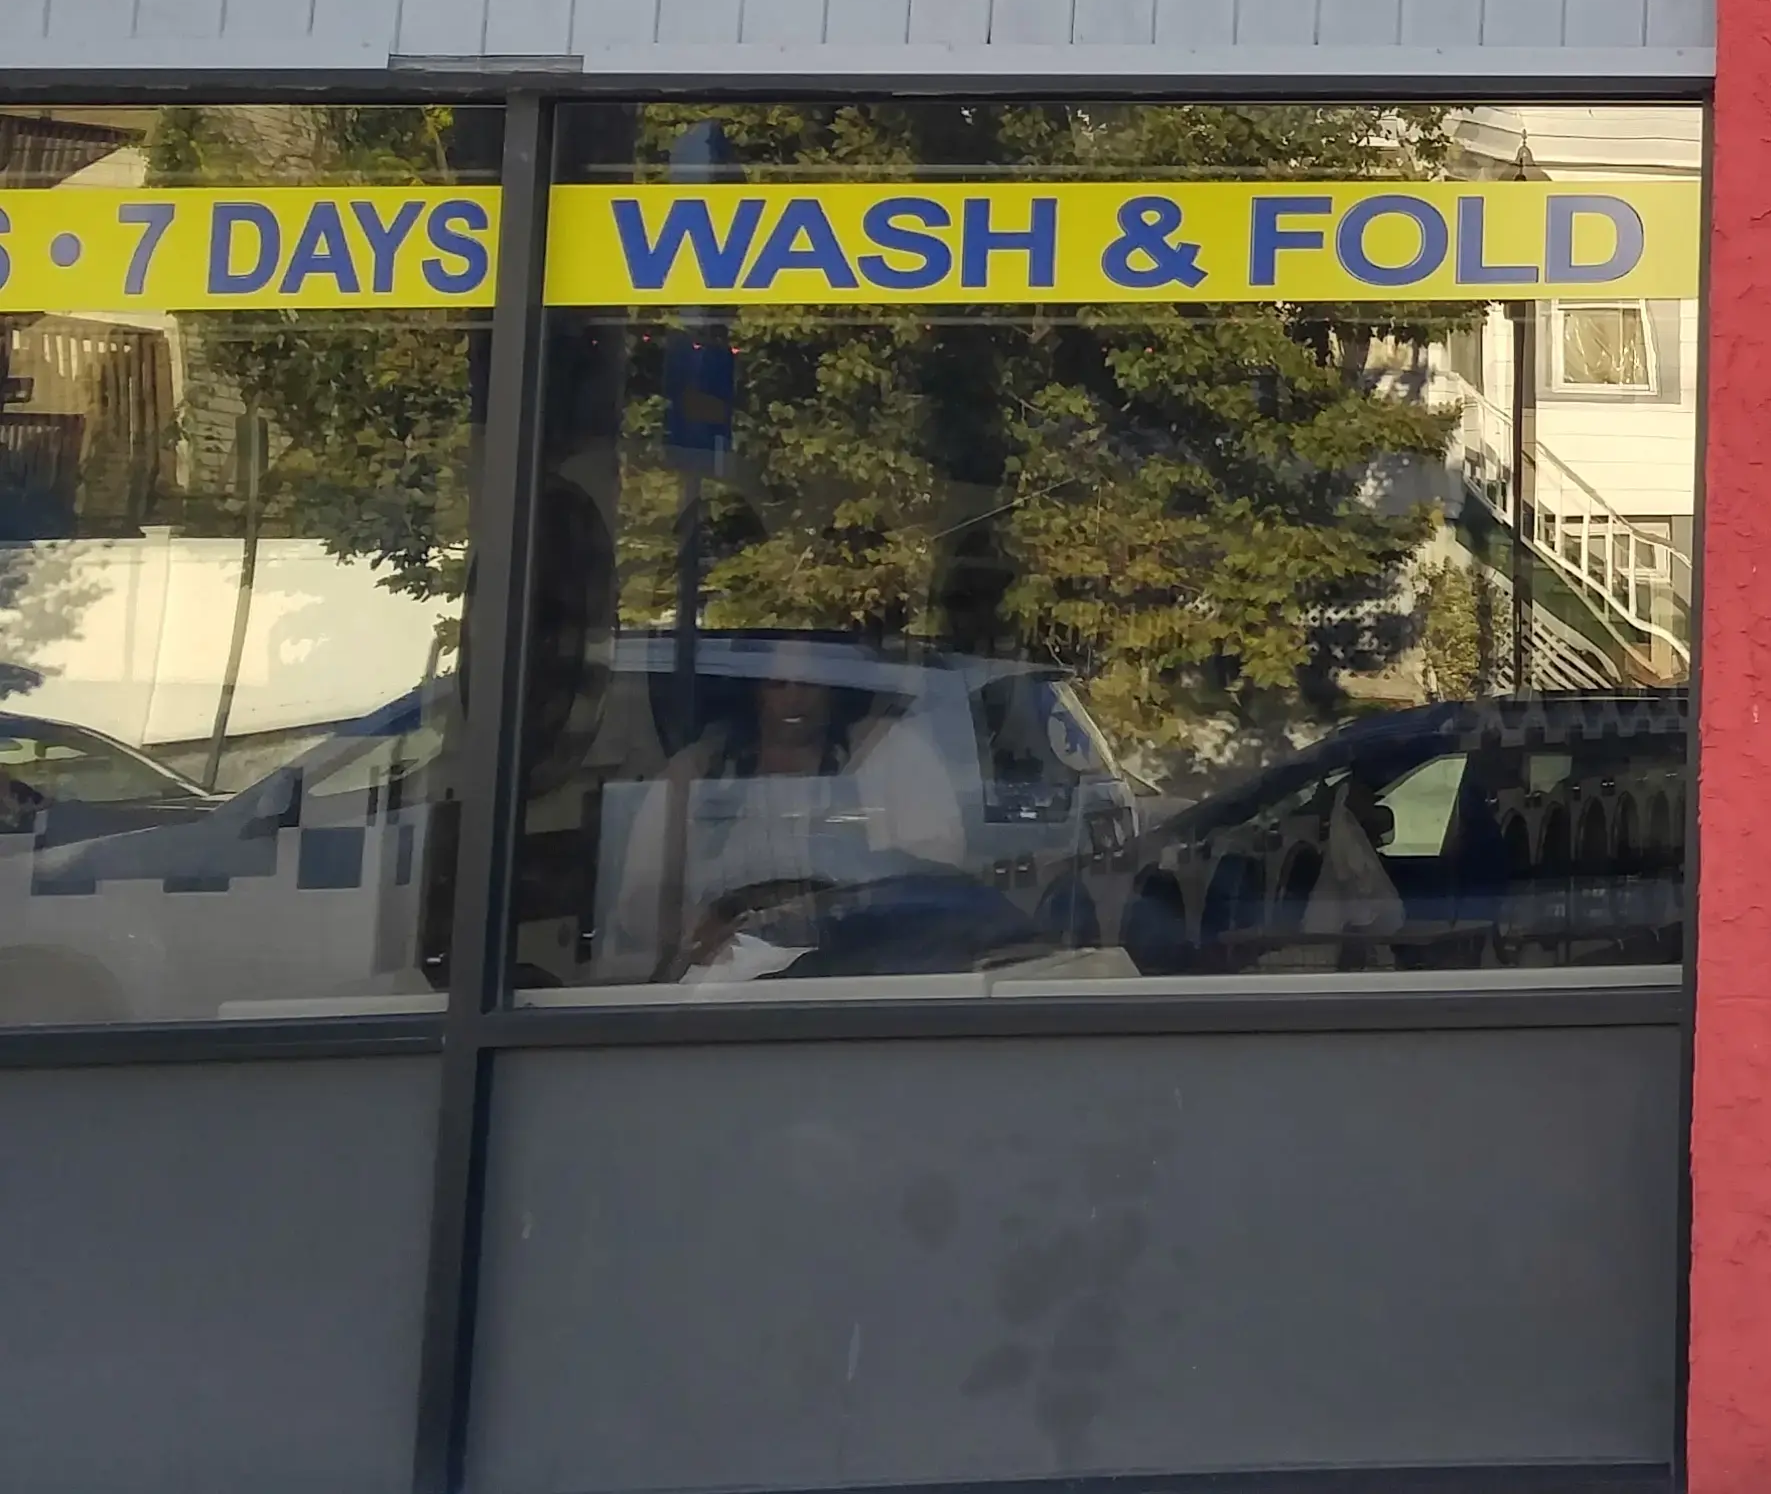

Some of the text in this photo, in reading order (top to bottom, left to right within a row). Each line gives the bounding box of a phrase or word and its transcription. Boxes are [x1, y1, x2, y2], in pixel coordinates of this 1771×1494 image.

[118, 203, 175, 294] 7
[208, 201, 489, 295] DAYS
[612, 195, 1645, 290] WASH & FOLD
